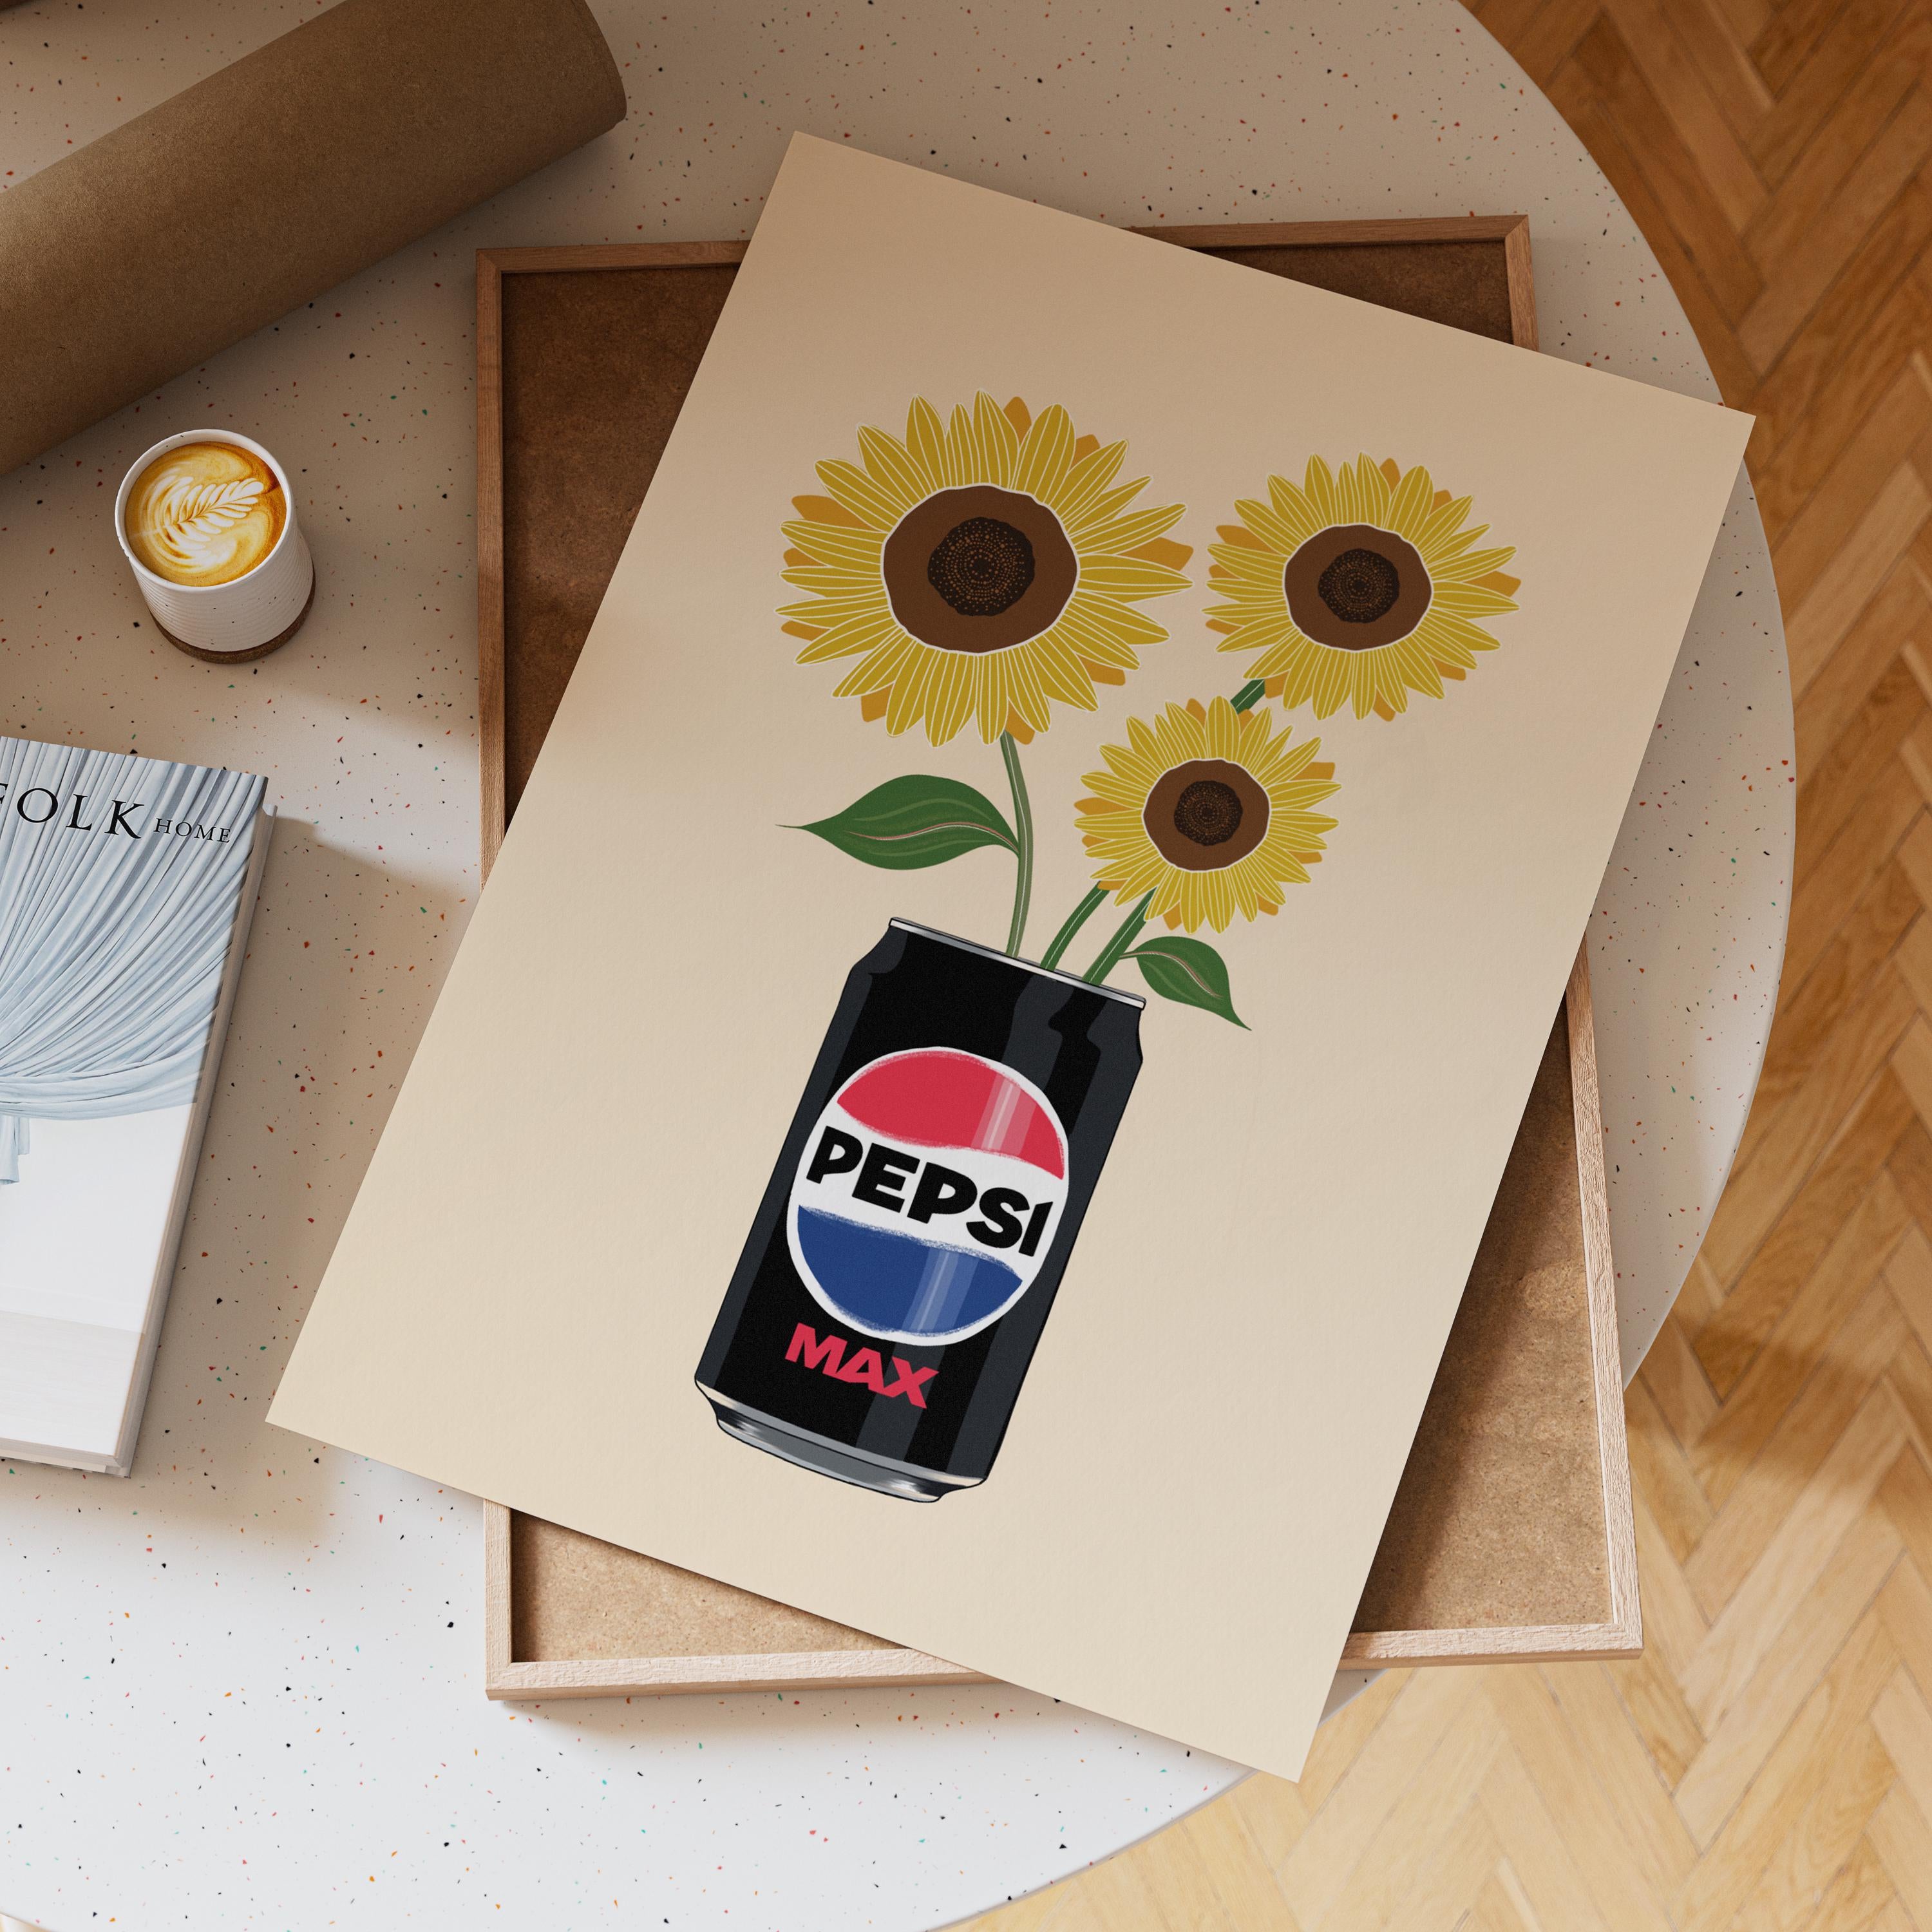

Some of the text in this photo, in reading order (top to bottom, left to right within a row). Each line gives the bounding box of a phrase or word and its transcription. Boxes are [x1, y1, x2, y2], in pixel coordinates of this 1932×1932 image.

[153, 818, 231, 843] HOME
[806, 1126, 1053, 1256] PEPSI
[785, 1323, 938, 1408] MAX
